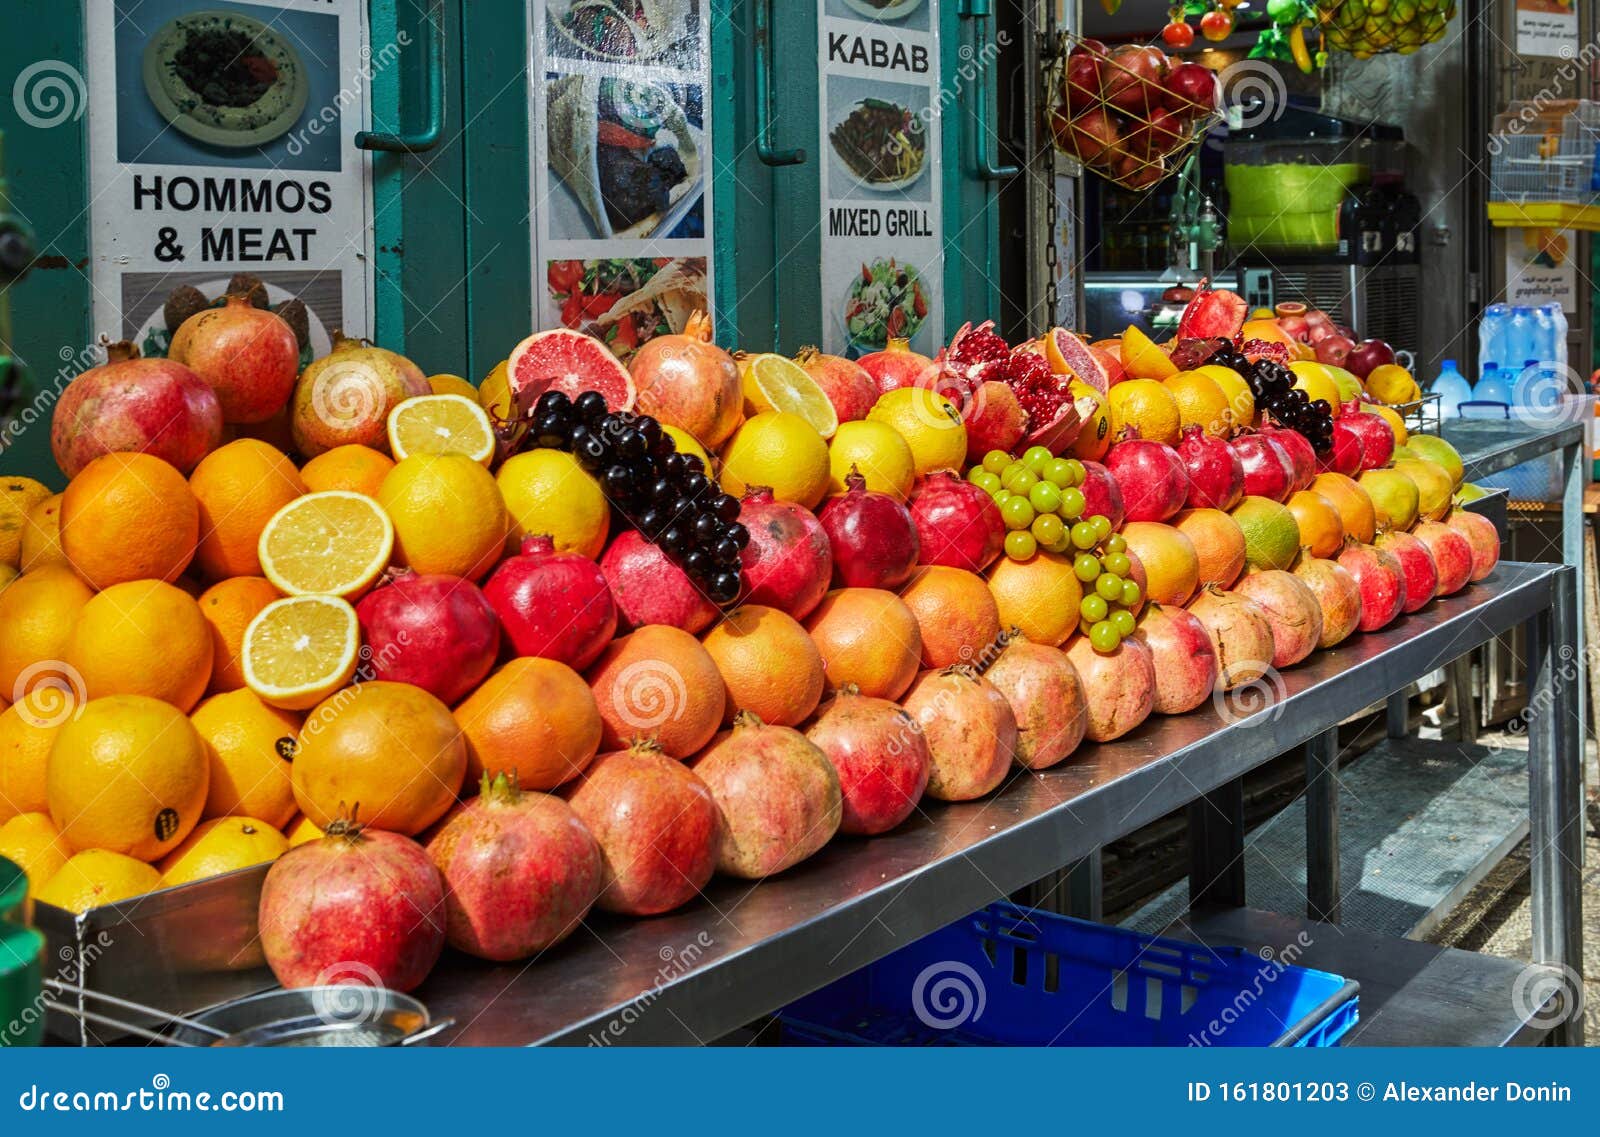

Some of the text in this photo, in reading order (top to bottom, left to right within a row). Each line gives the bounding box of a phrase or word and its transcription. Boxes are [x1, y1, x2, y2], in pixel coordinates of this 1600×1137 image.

[829, 32, 929, 74] KABAB
[133, 175, 332, 214] HOMMOS
[829, 208, 932, 237] MIXED GRILL
[154, 227, 317, 263] & MEAT
